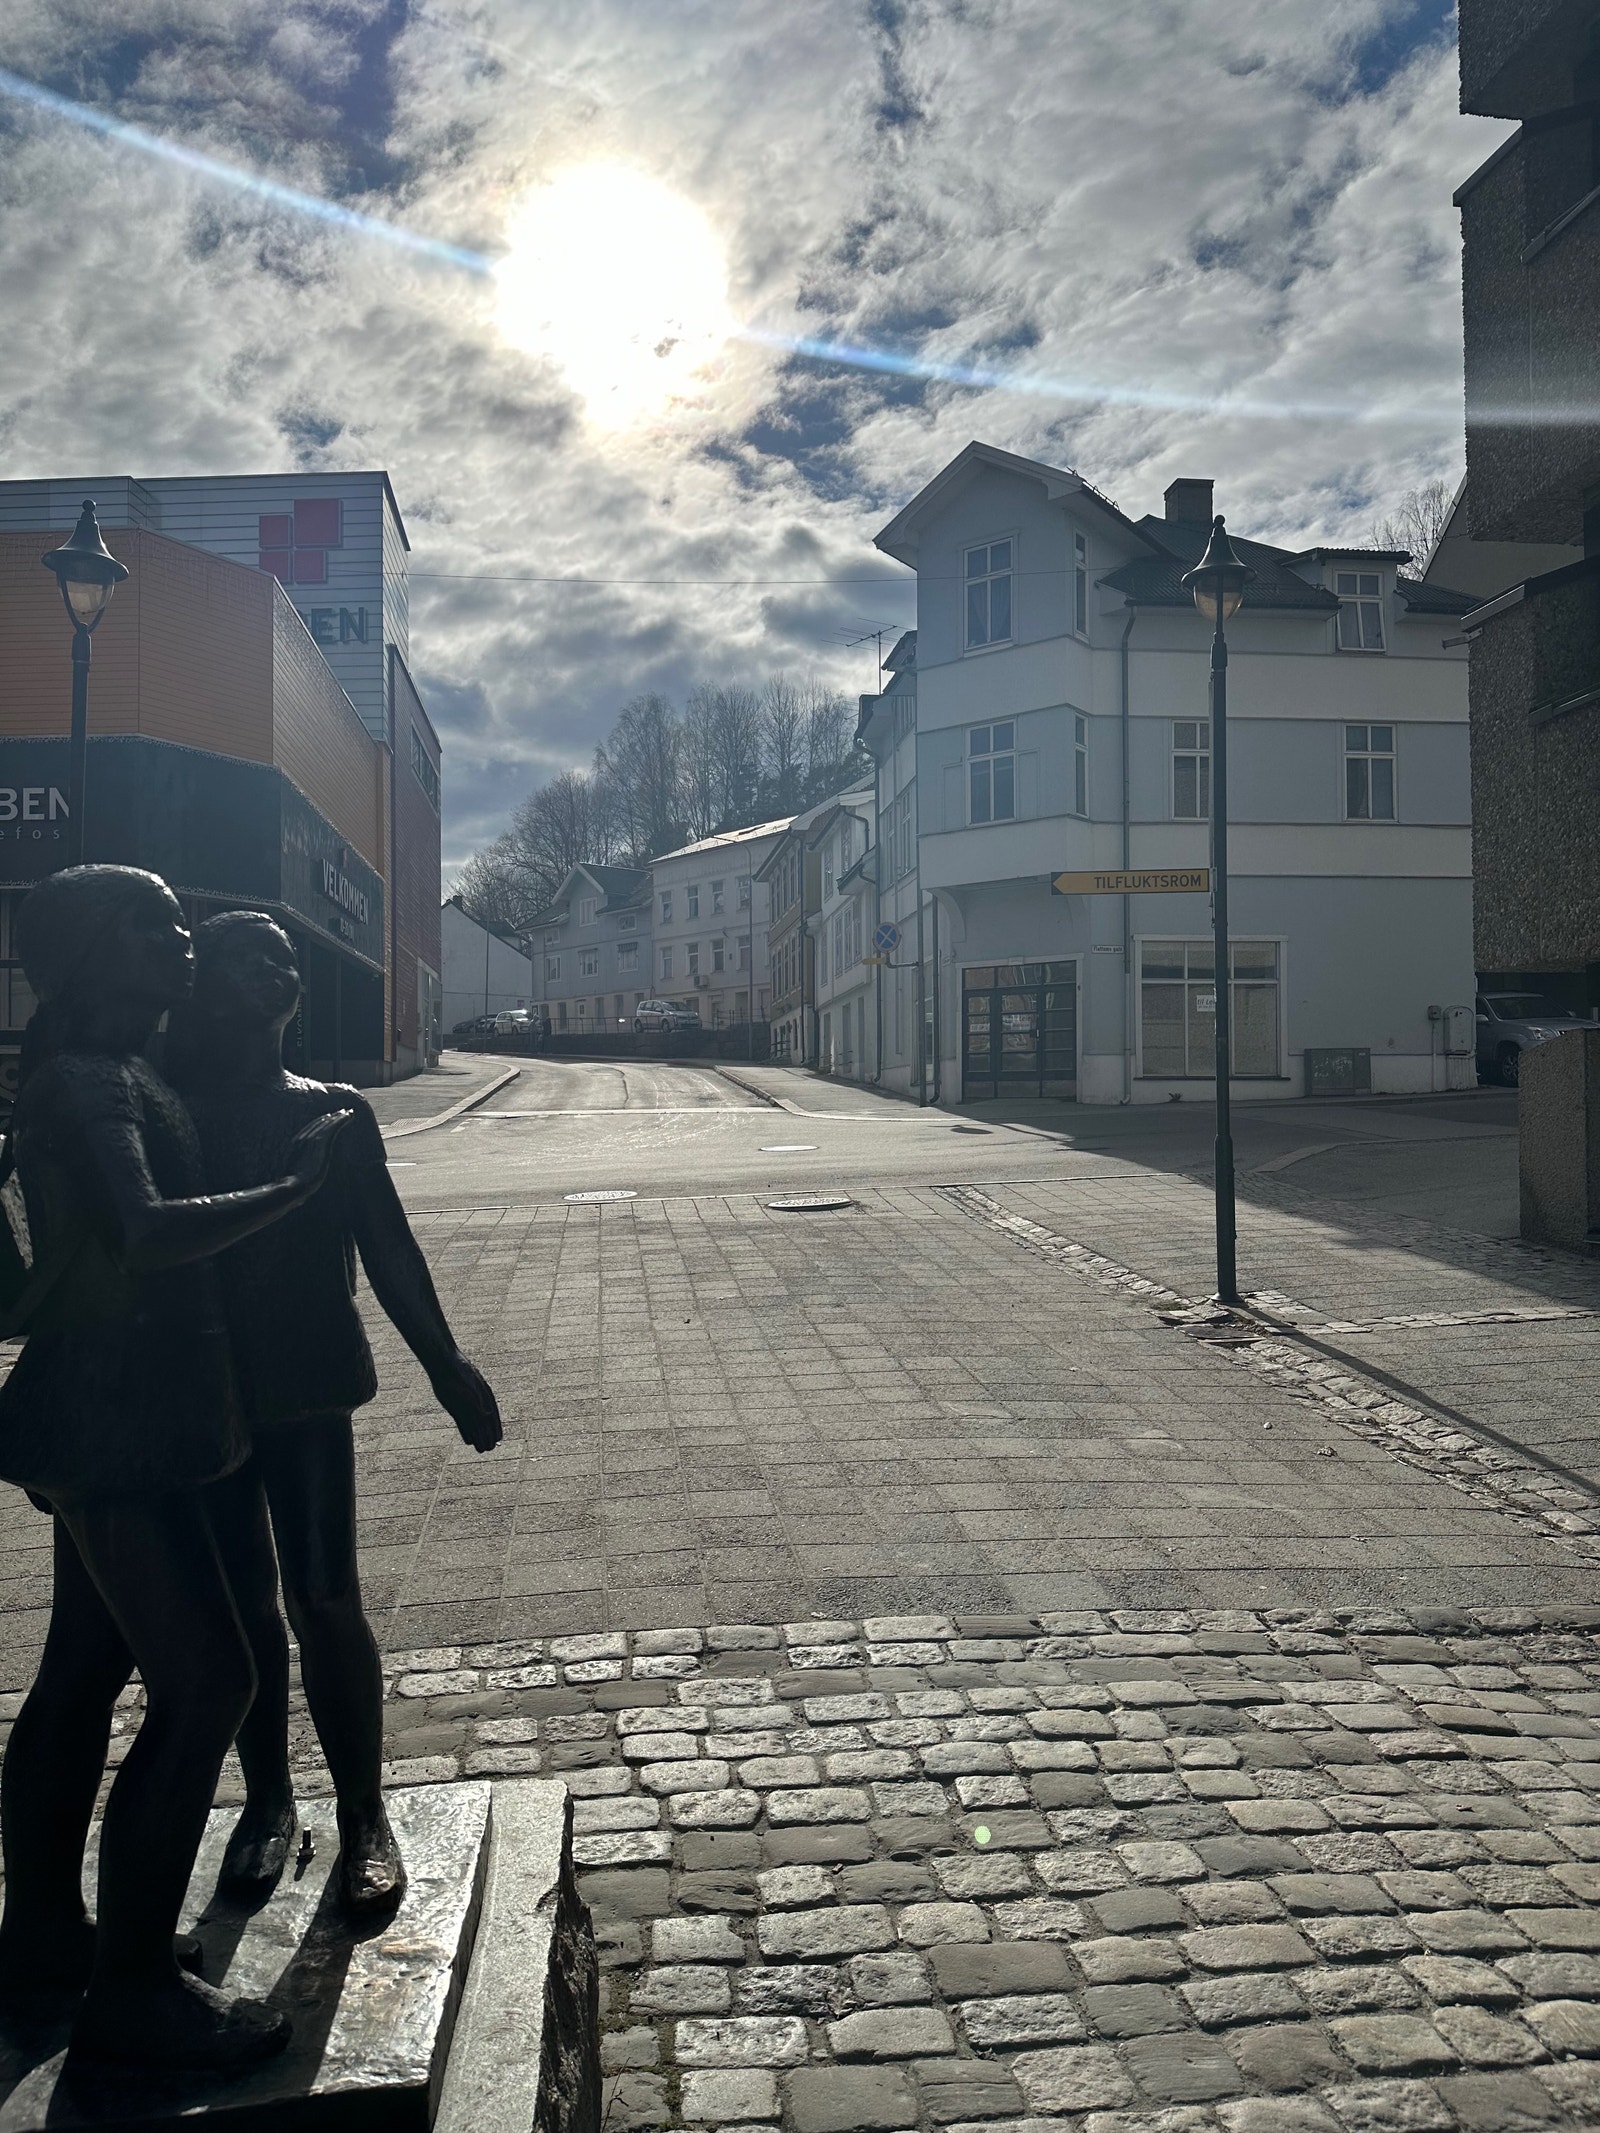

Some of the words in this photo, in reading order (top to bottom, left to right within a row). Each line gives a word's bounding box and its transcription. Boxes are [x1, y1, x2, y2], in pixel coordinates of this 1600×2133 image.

[296, 608, 368, 644] EN
[322, 858, 369, 926] VELKOMMEN
[1093, 874, 1202, 889] TILFLUKTSROM
